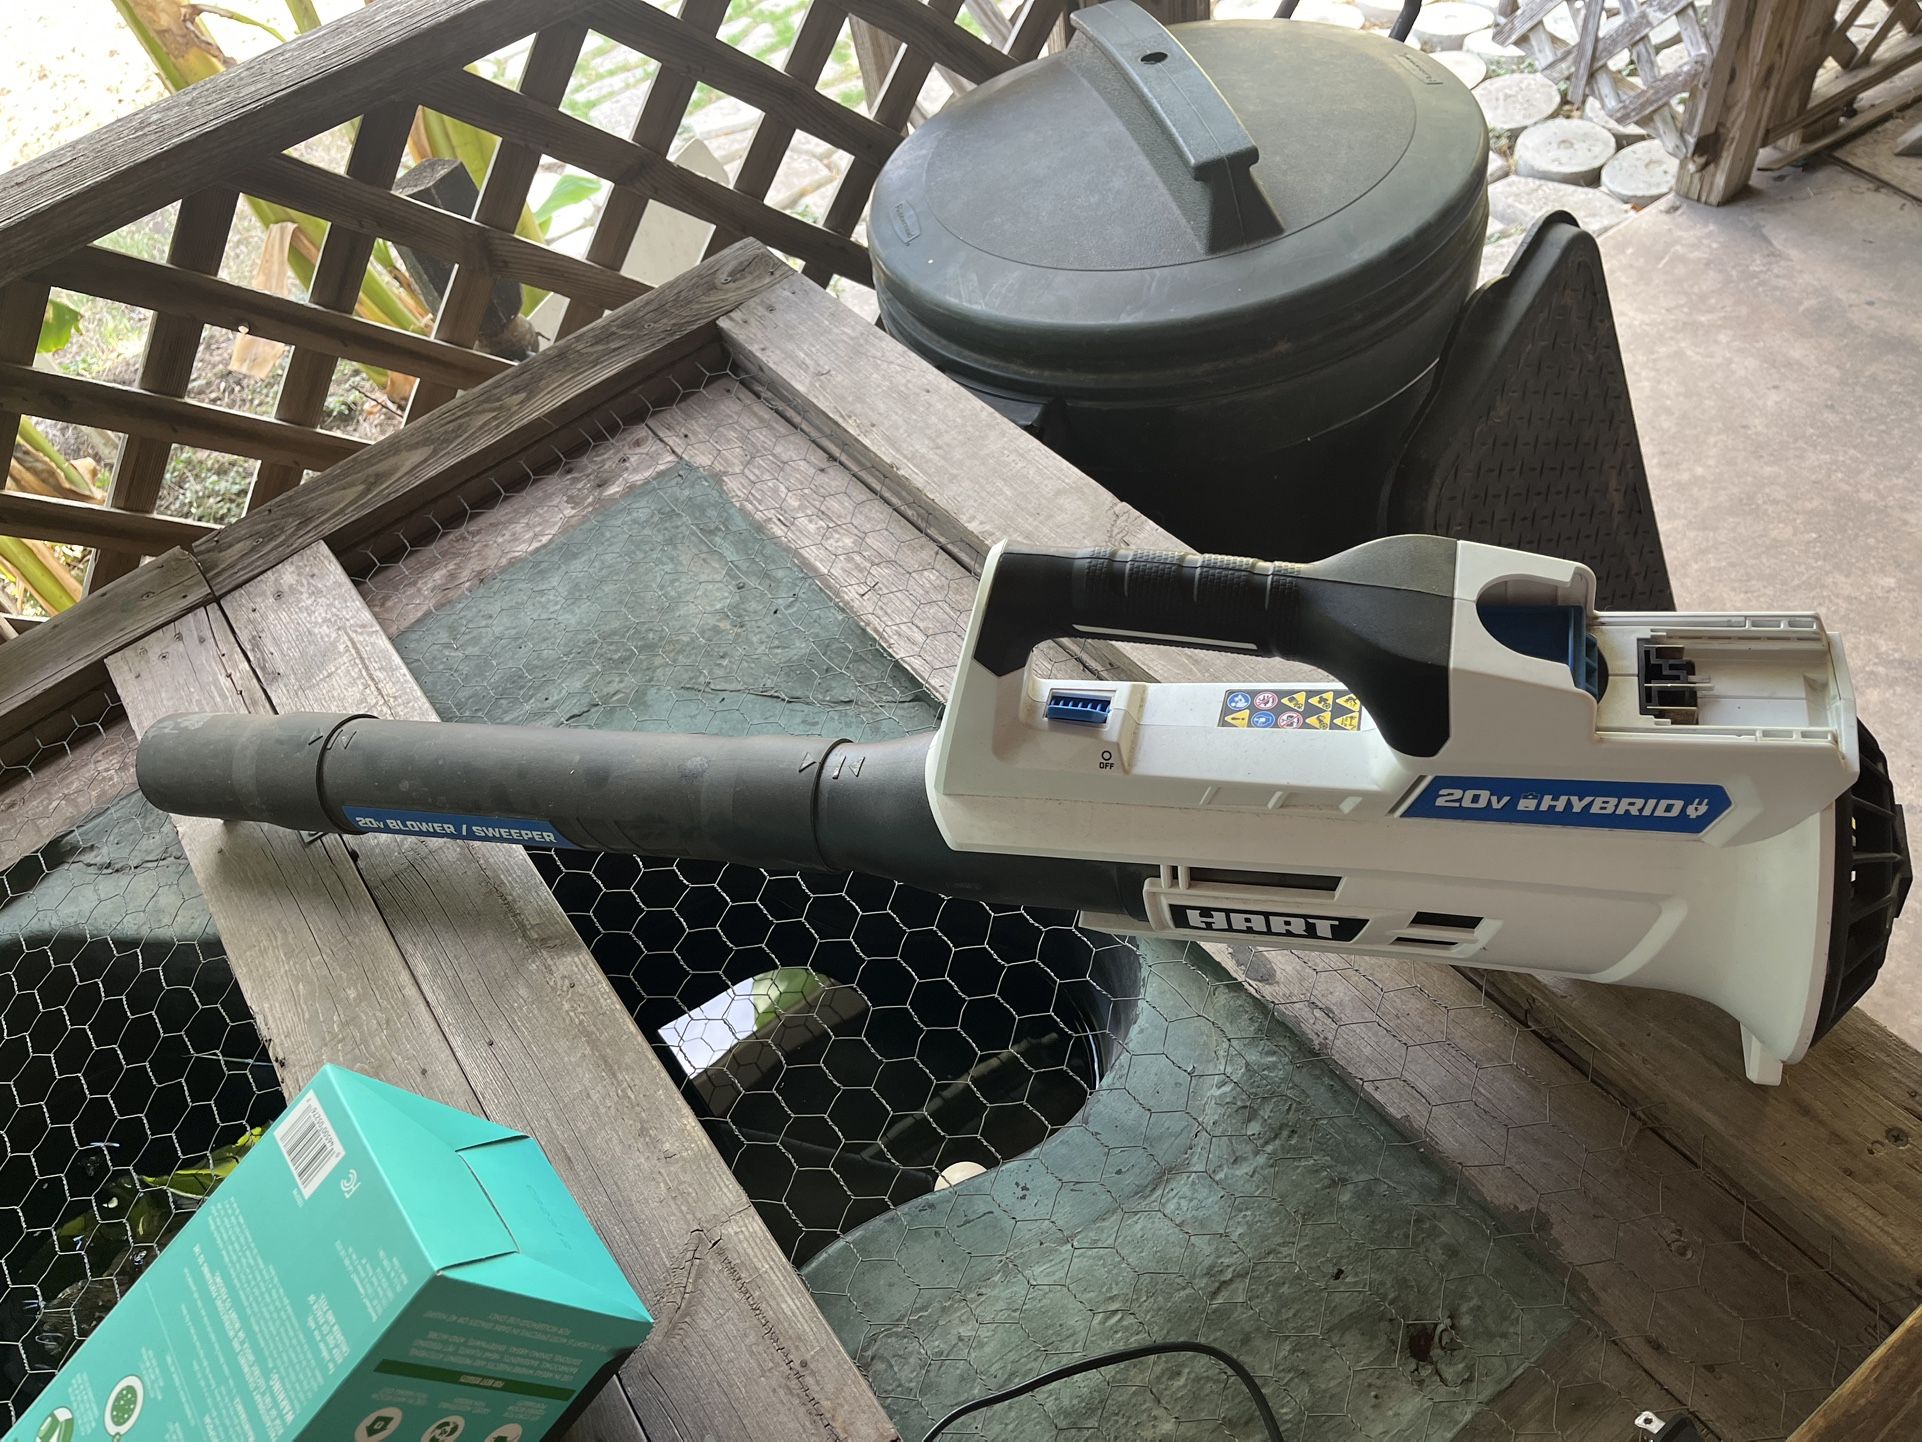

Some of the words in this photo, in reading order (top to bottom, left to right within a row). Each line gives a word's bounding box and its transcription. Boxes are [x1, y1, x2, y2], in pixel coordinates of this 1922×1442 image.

[1099, 762, 1115, 770] OFF
[1539, 795, 1685, 817] HYBRID
[386, 819, 458, 835] BLOWER
[472, 826, 558, 842] SWEEPER
[1186, 909, 1339, 939] HART
